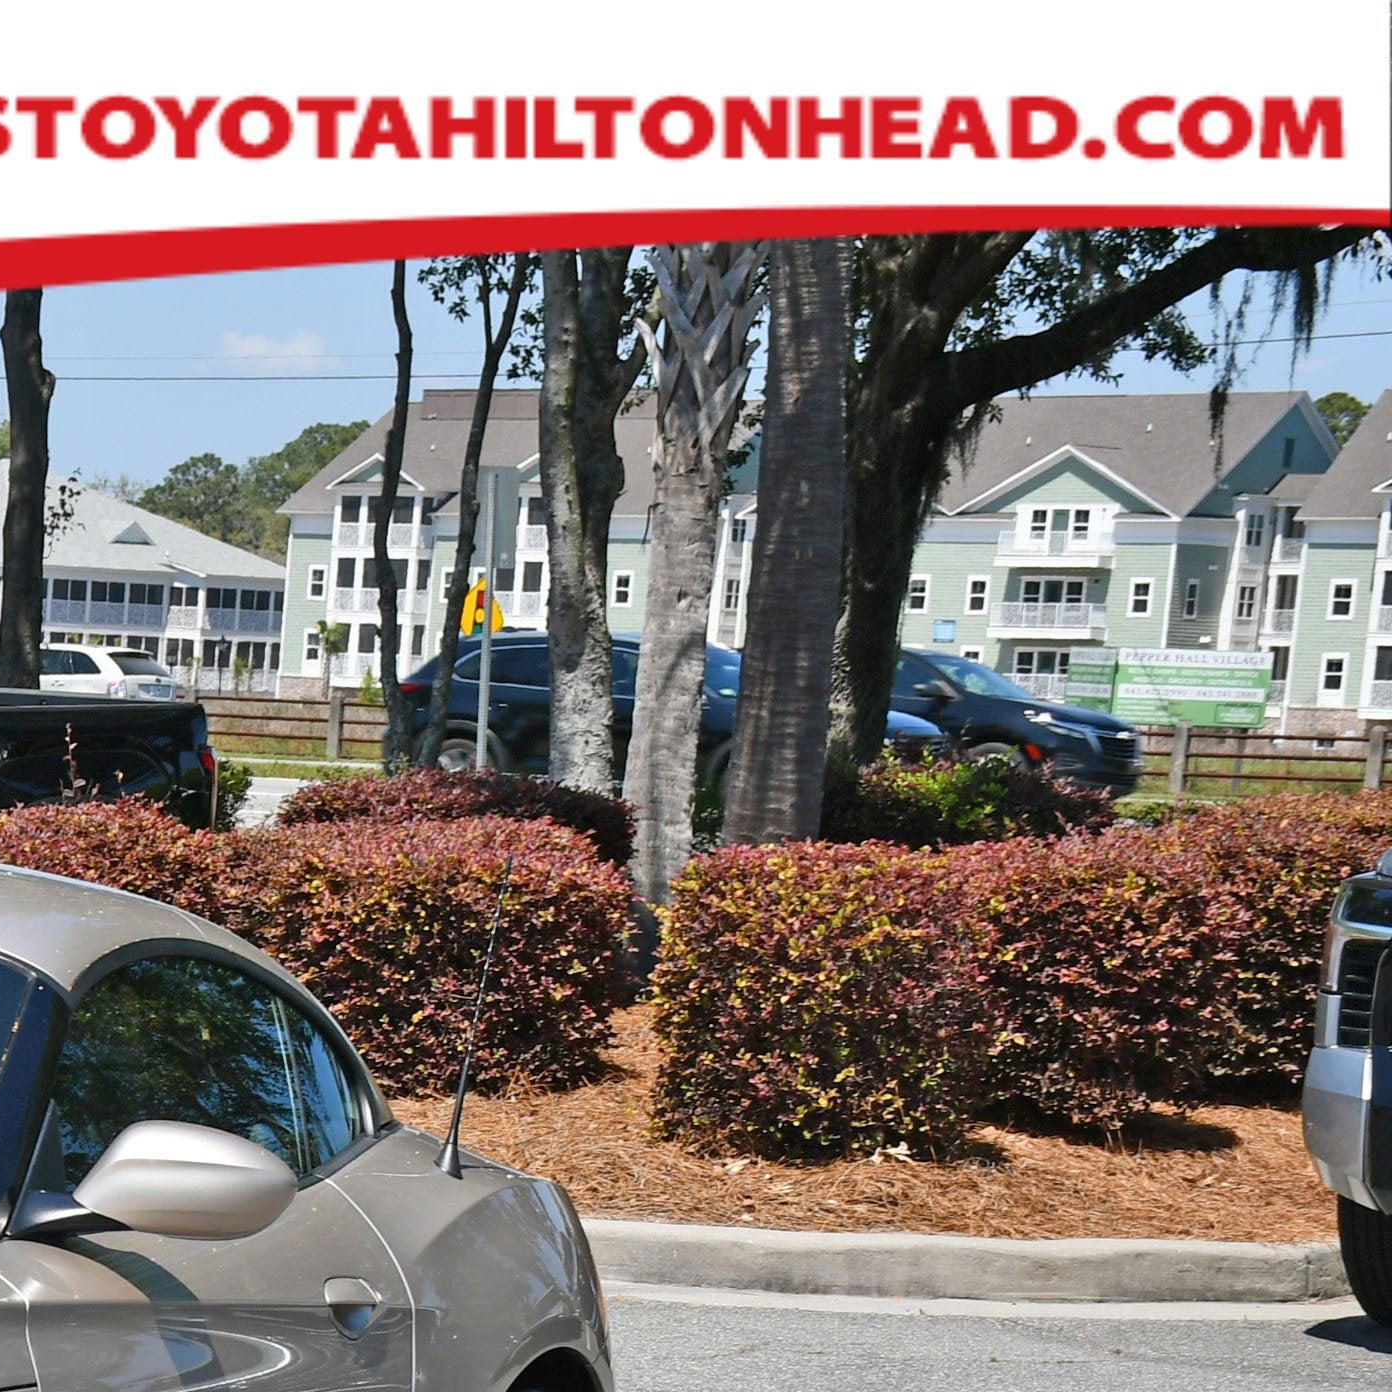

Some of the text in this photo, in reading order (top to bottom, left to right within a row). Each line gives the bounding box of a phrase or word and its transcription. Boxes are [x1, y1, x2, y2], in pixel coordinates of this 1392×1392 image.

[1124, 653, 1169, 663] PEPPER
[1175, 654, 1209, 664] HALL
[1212, 655, 1265, 666] VILLAGE
